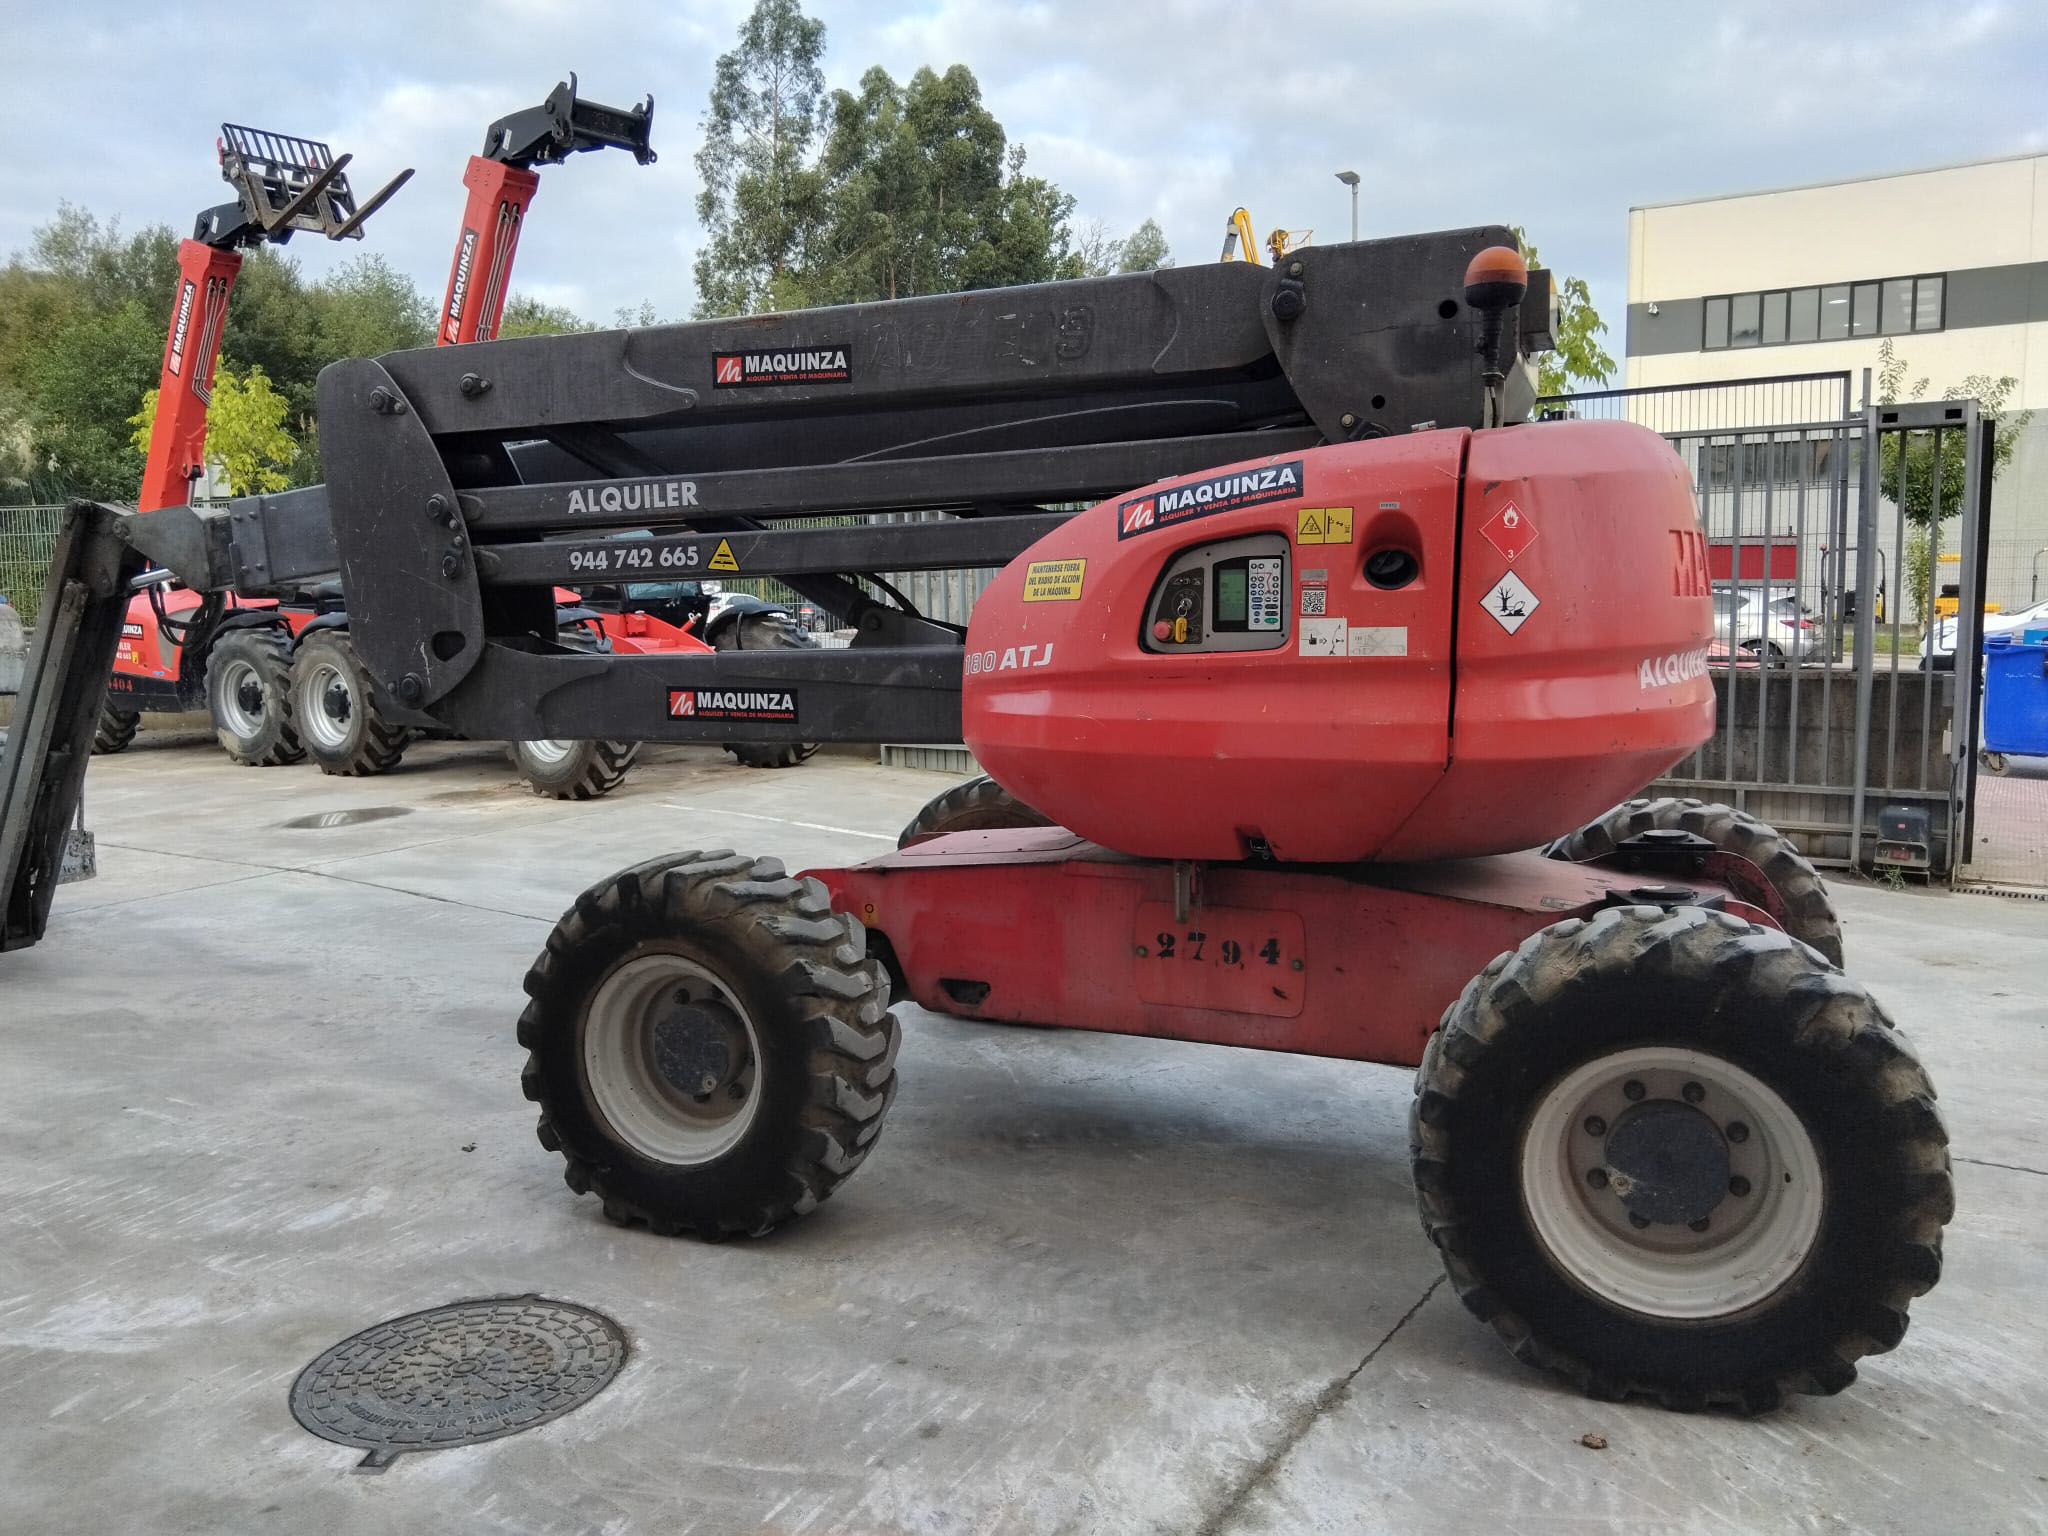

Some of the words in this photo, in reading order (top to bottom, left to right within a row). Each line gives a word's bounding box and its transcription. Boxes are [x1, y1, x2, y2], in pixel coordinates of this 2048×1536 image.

[450, 233, 475, 317] MAQUINZA
[172, 283, 193, 354] MAQUINZA
[745, 351, 847, 373] MAQUINZA
[568, 481, 699, 514] ALQUILER
[1159, 467, 1297, 513] MAQUINZA
[1159, 508, 1195, 522] ALQUILER
[1203, 501, 1228, 511] VENTA
[1230, 497, 1241, 505] DE
[1242, 486, 1297, 503] MAQUINARIA
[569, 551, 609, 571] 944
[614, 547, 654, 569] 742
[659, 546, 699, 567] 665
[1063, 562, 1080, 572] FUERA
[1507, 549, 1514, 559] 3
[1032, 588, 1040, 597] DE
[1040, 588, 1047, 596] LA
[1037, 575, 1054, 585] RADIO
[1053, 575, 1062, 585] DE
[965, 650, 997, 676] 180
[998, 642, 1054, 671] ATJ
[697, 691, 795, 710] MAQUINZA
[1156, 931, 1281, 967] 2794
